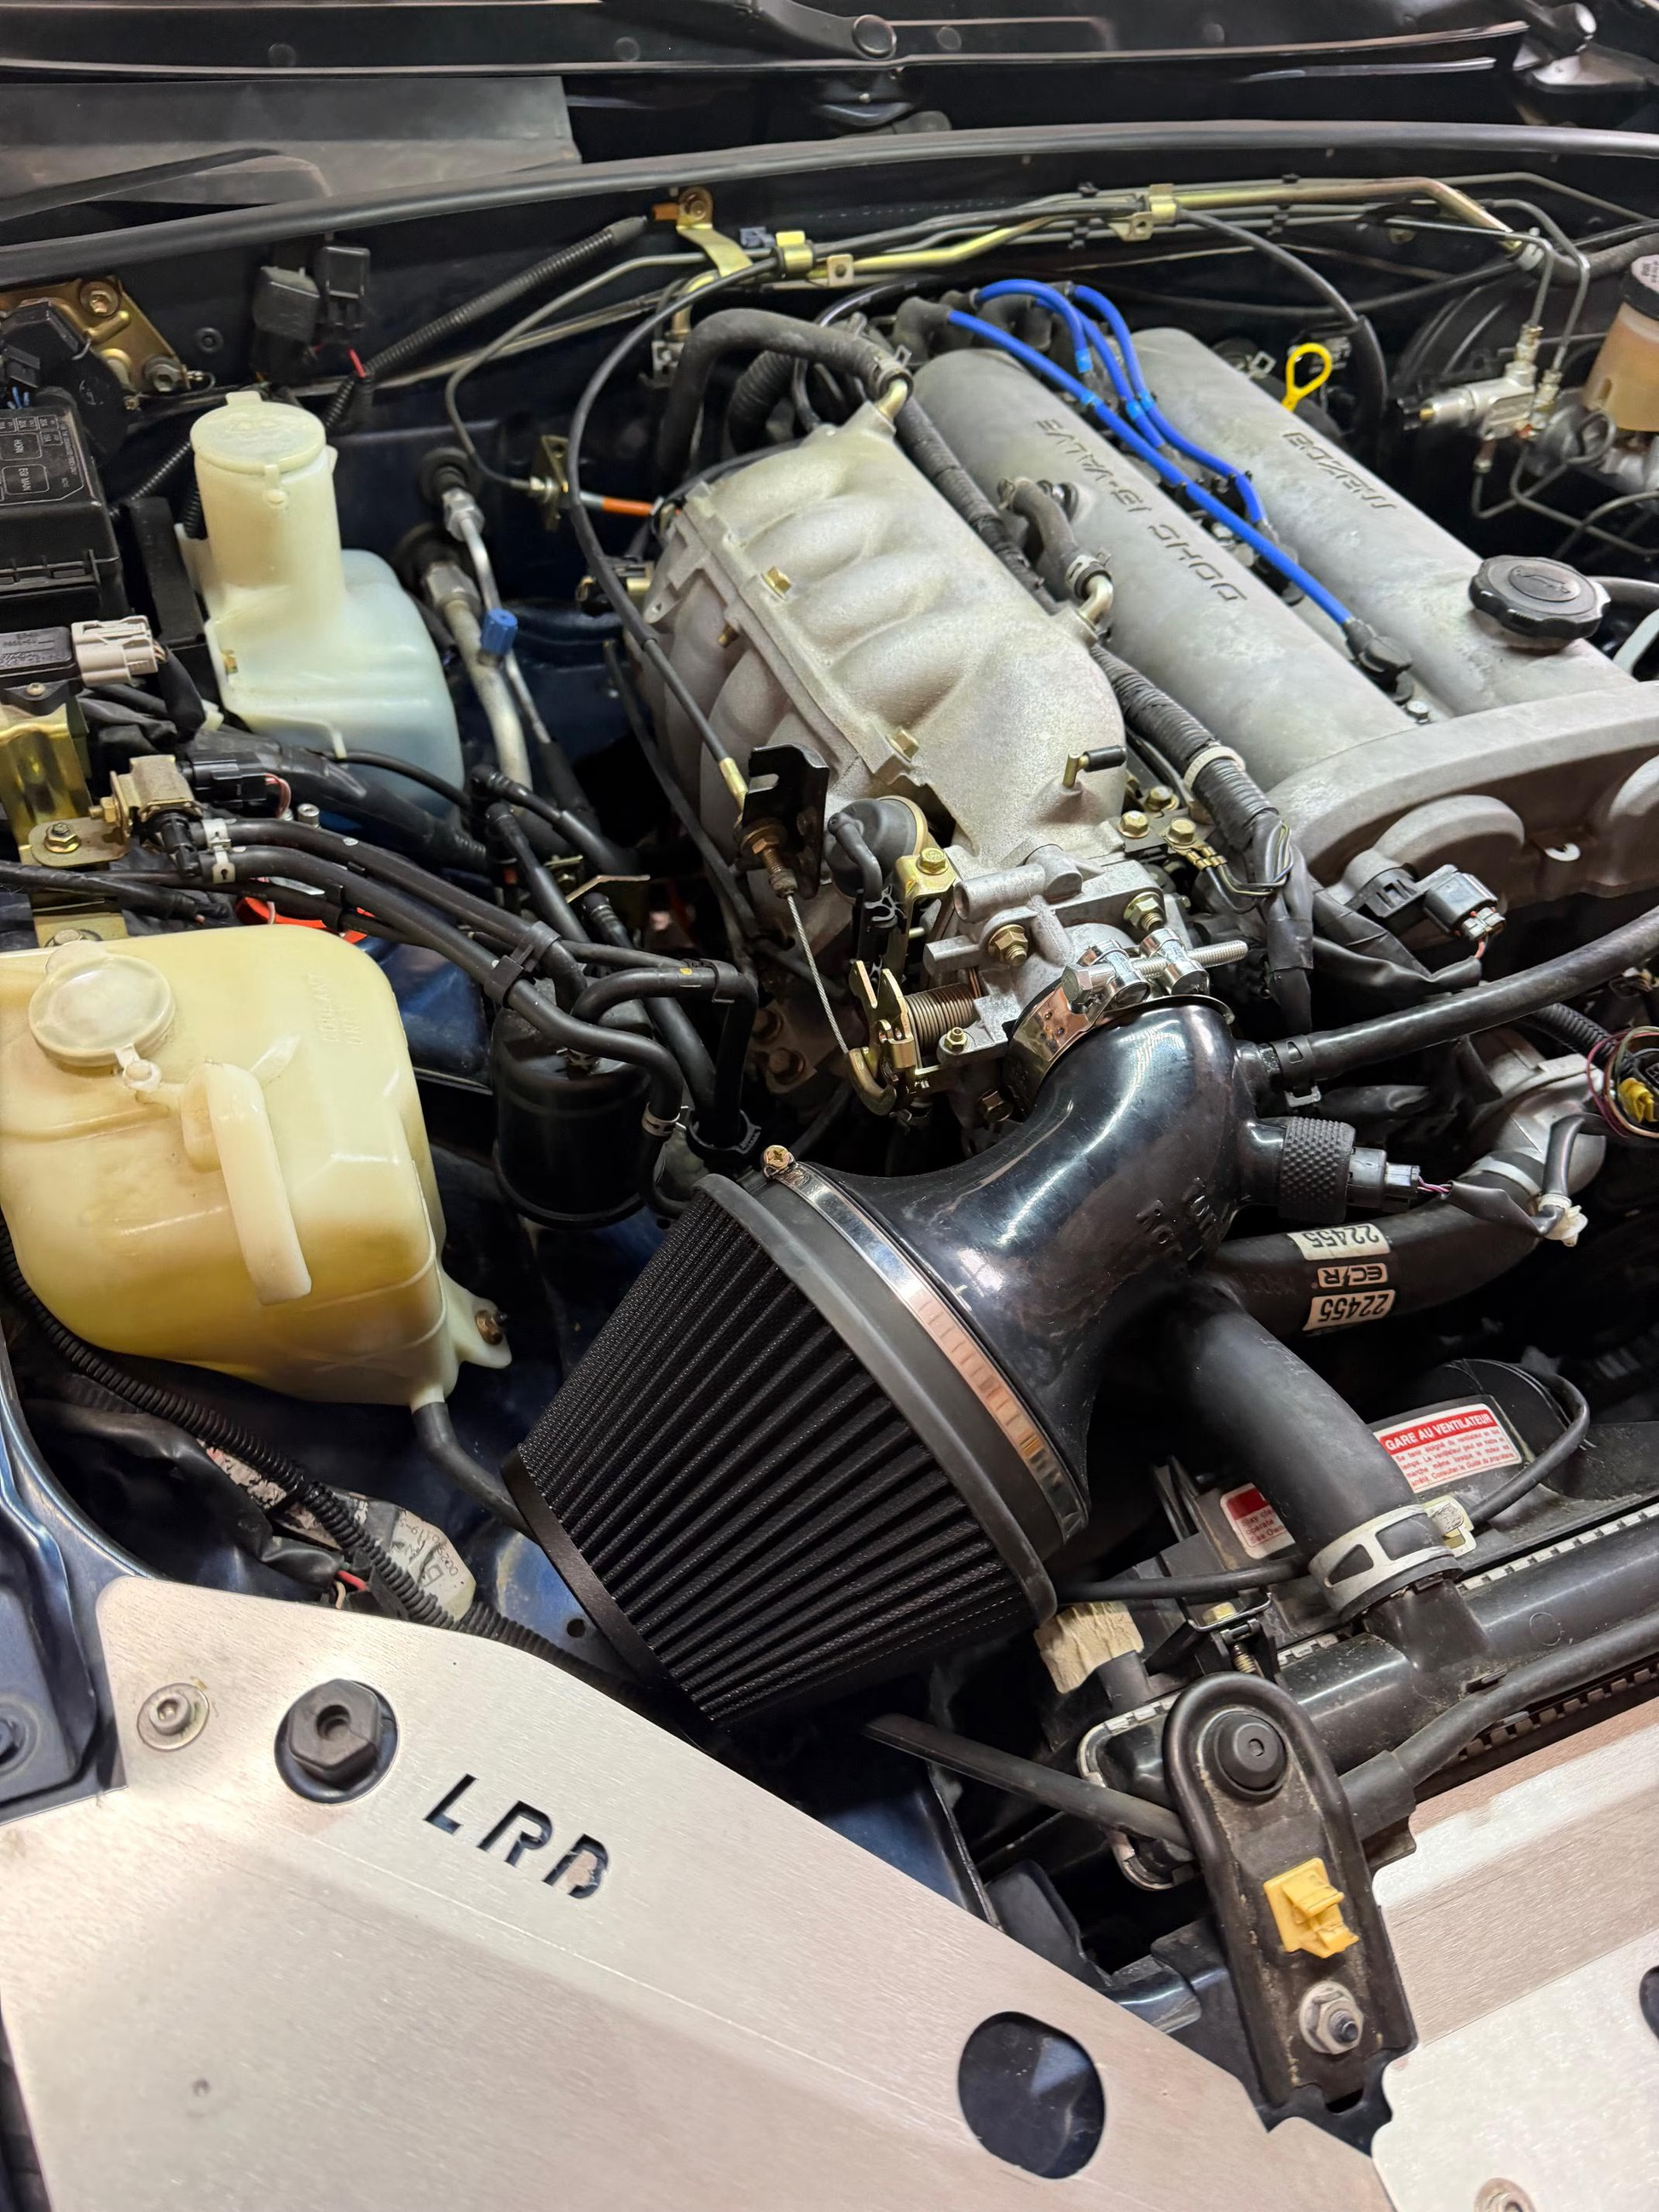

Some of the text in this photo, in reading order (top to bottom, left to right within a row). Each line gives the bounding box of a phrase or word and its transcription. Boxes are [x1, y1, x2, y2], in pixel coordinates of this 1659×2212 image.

[1036, 419, 1248, 602] DOHC 16-VALVE
[1301, 1225, 1379, 1247] 22455
[1317, 1293, 1390, 1322] 22455
[1384, 1413, 1493, 1451] GARE AU VENTILATEUR
